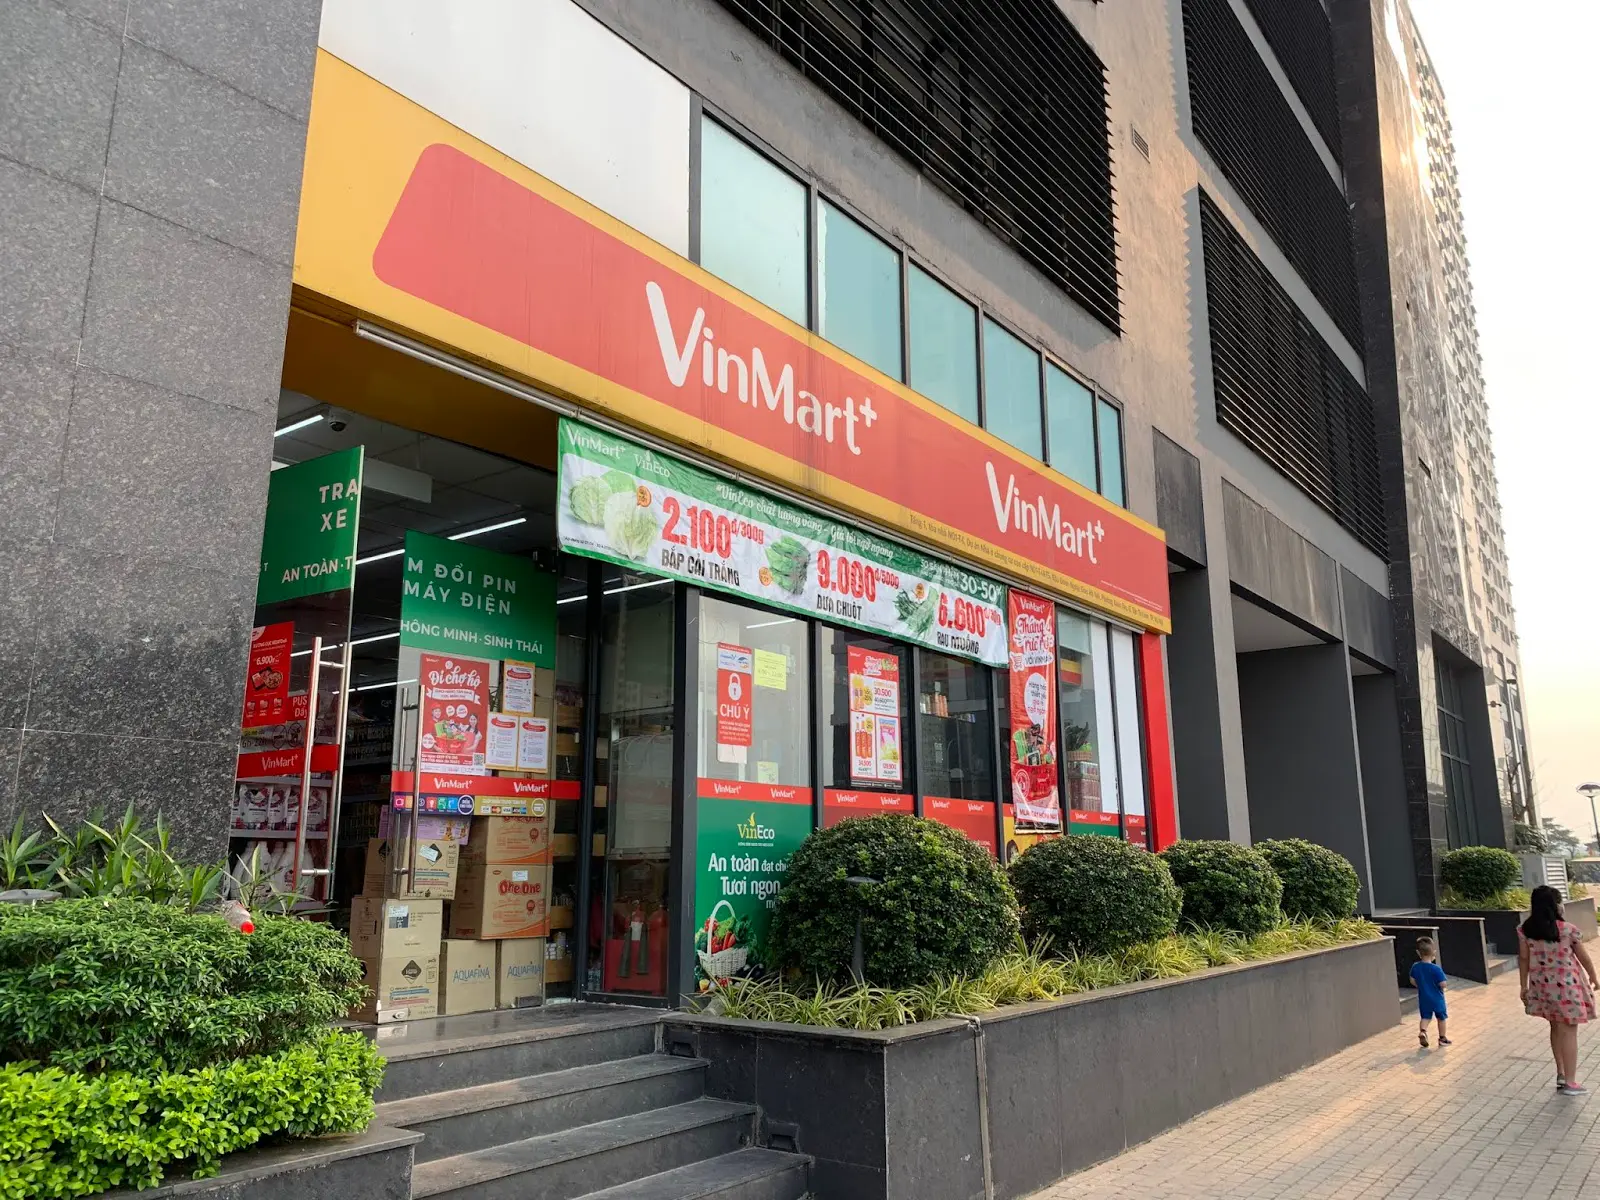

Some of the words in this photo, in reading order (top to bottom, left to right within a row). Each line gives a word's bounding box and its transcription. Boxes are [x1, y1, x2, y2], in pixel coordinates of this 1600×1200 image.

[646, 281, 878, 456] VinMart+
[565, 424, 626, 460] VinMart+
[634, 452, 671, 478] VinEco
[320, 508, 347, 532] XE
[985, 461, 1105, 564] VinMart+
[281, 567, 300, 584] AN
[661, 545, 685, 571] BẮP
[708, 560, 740, 586] TRẮNG
[434, 563, 472, 585] ĐỔI
[483, 574, 516, 594] PIN
[404, 580, 450, 603] MÁY
[460, 592, 511, 616] ĐIỆN
[516, 640, 543, 654] THÁI
[428, 669, 444, 686] Đi
[445, 665, 467, 687] chợ
[467, 669, 482, 690] hộ
[719, 703, 741, 719] CHÚ
[743, 704, 750, 720] Ý
[261, 753, 299, 771] VinMart+
[433, 777, 473, 790] VinMart+
[513, 781, 549, 793] VinMart+
[713, 782, 742, 796] VinMart+
[737, 823, 775, 840] VinEco
[708, 853, 727, 872] An
[730, 853, 759, 872] toàn
[761, 859, 774, 875] đạt
[720, 876, 747, 895] Tươi
[750, 880, 780, 900] ngon
[453, 965, 491, 983] AQUAFINA
